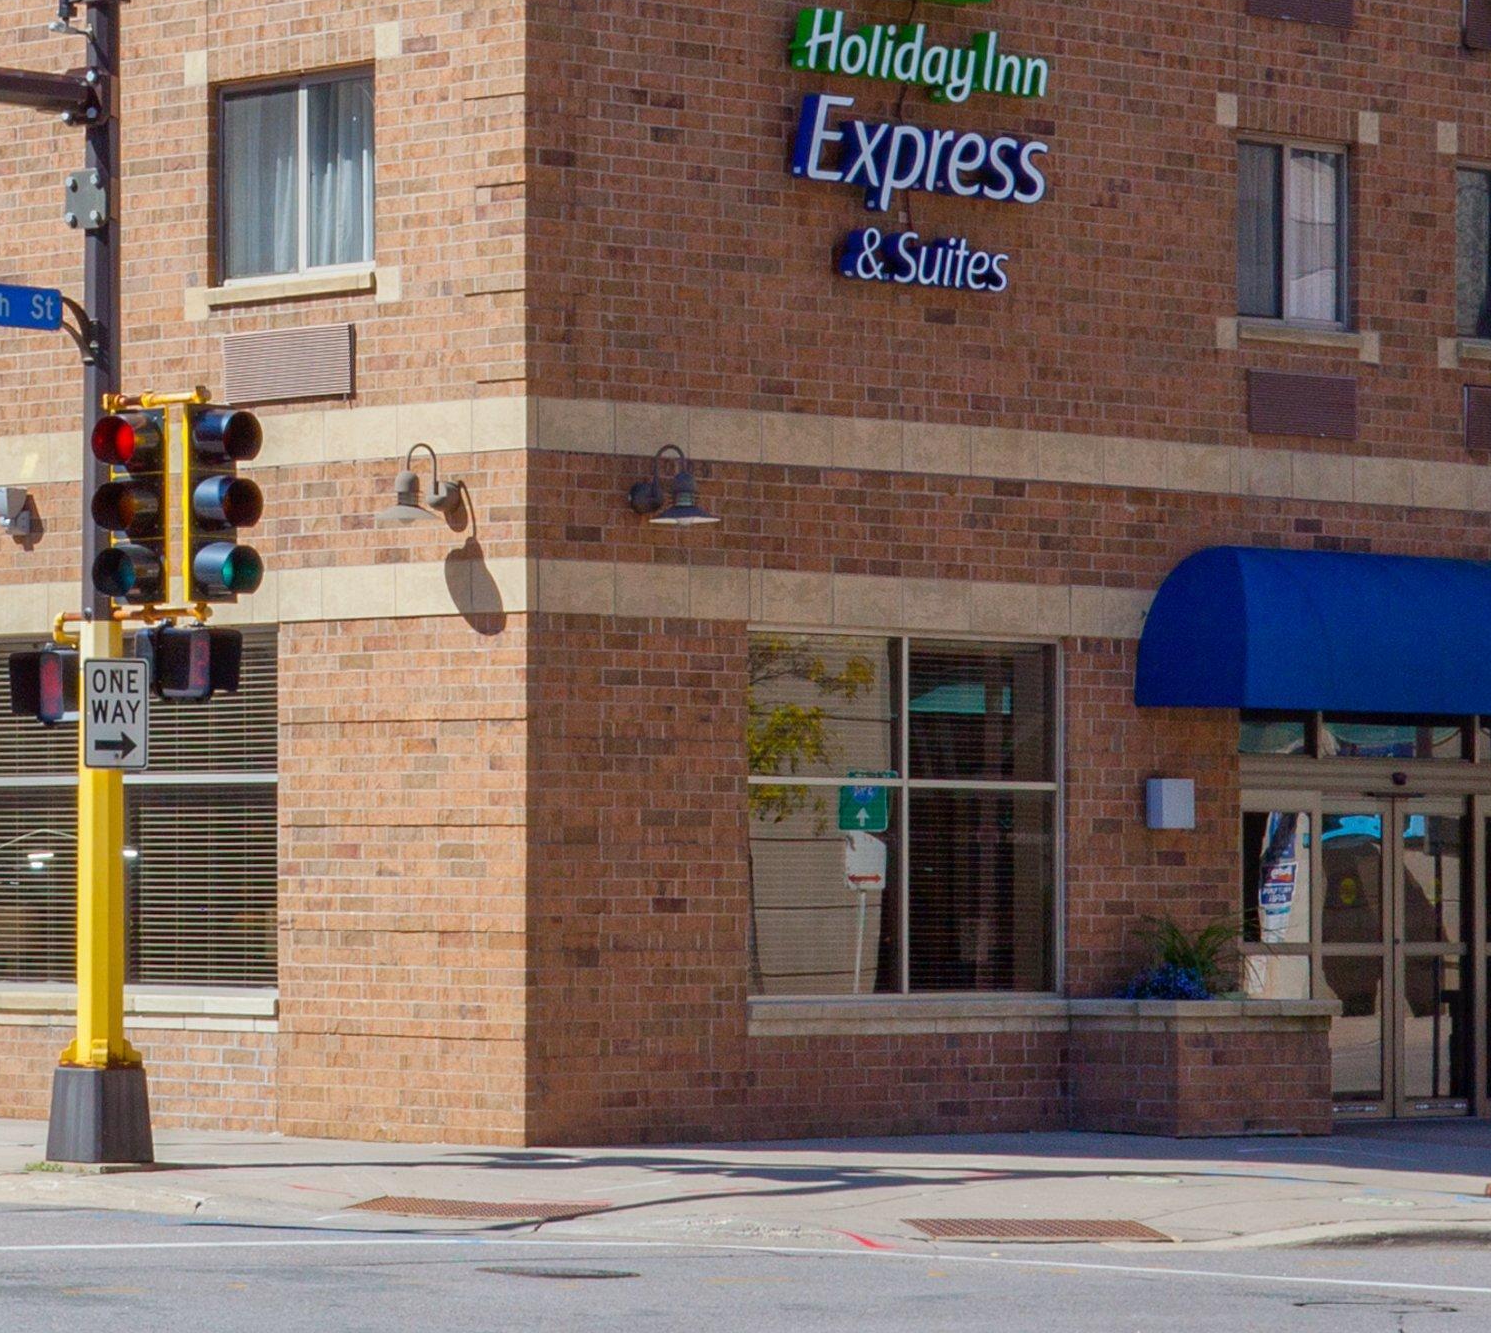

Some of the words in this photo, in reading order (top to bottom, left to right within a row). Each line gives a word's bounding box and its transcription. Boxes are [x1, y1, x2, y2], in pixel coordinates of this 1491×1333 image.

[805, 8, 976, 103] Holiday
[984, 31, 1049, 97] Inn
[807, 94, 1050, 212] Express
[856, 227, 886, 280] &
[894, 231, 1009, 292] Suites
[30, 294, 54, 321] St
[92, 669, 138, 693] ONE
[91, 699, 141, 724] WAY
